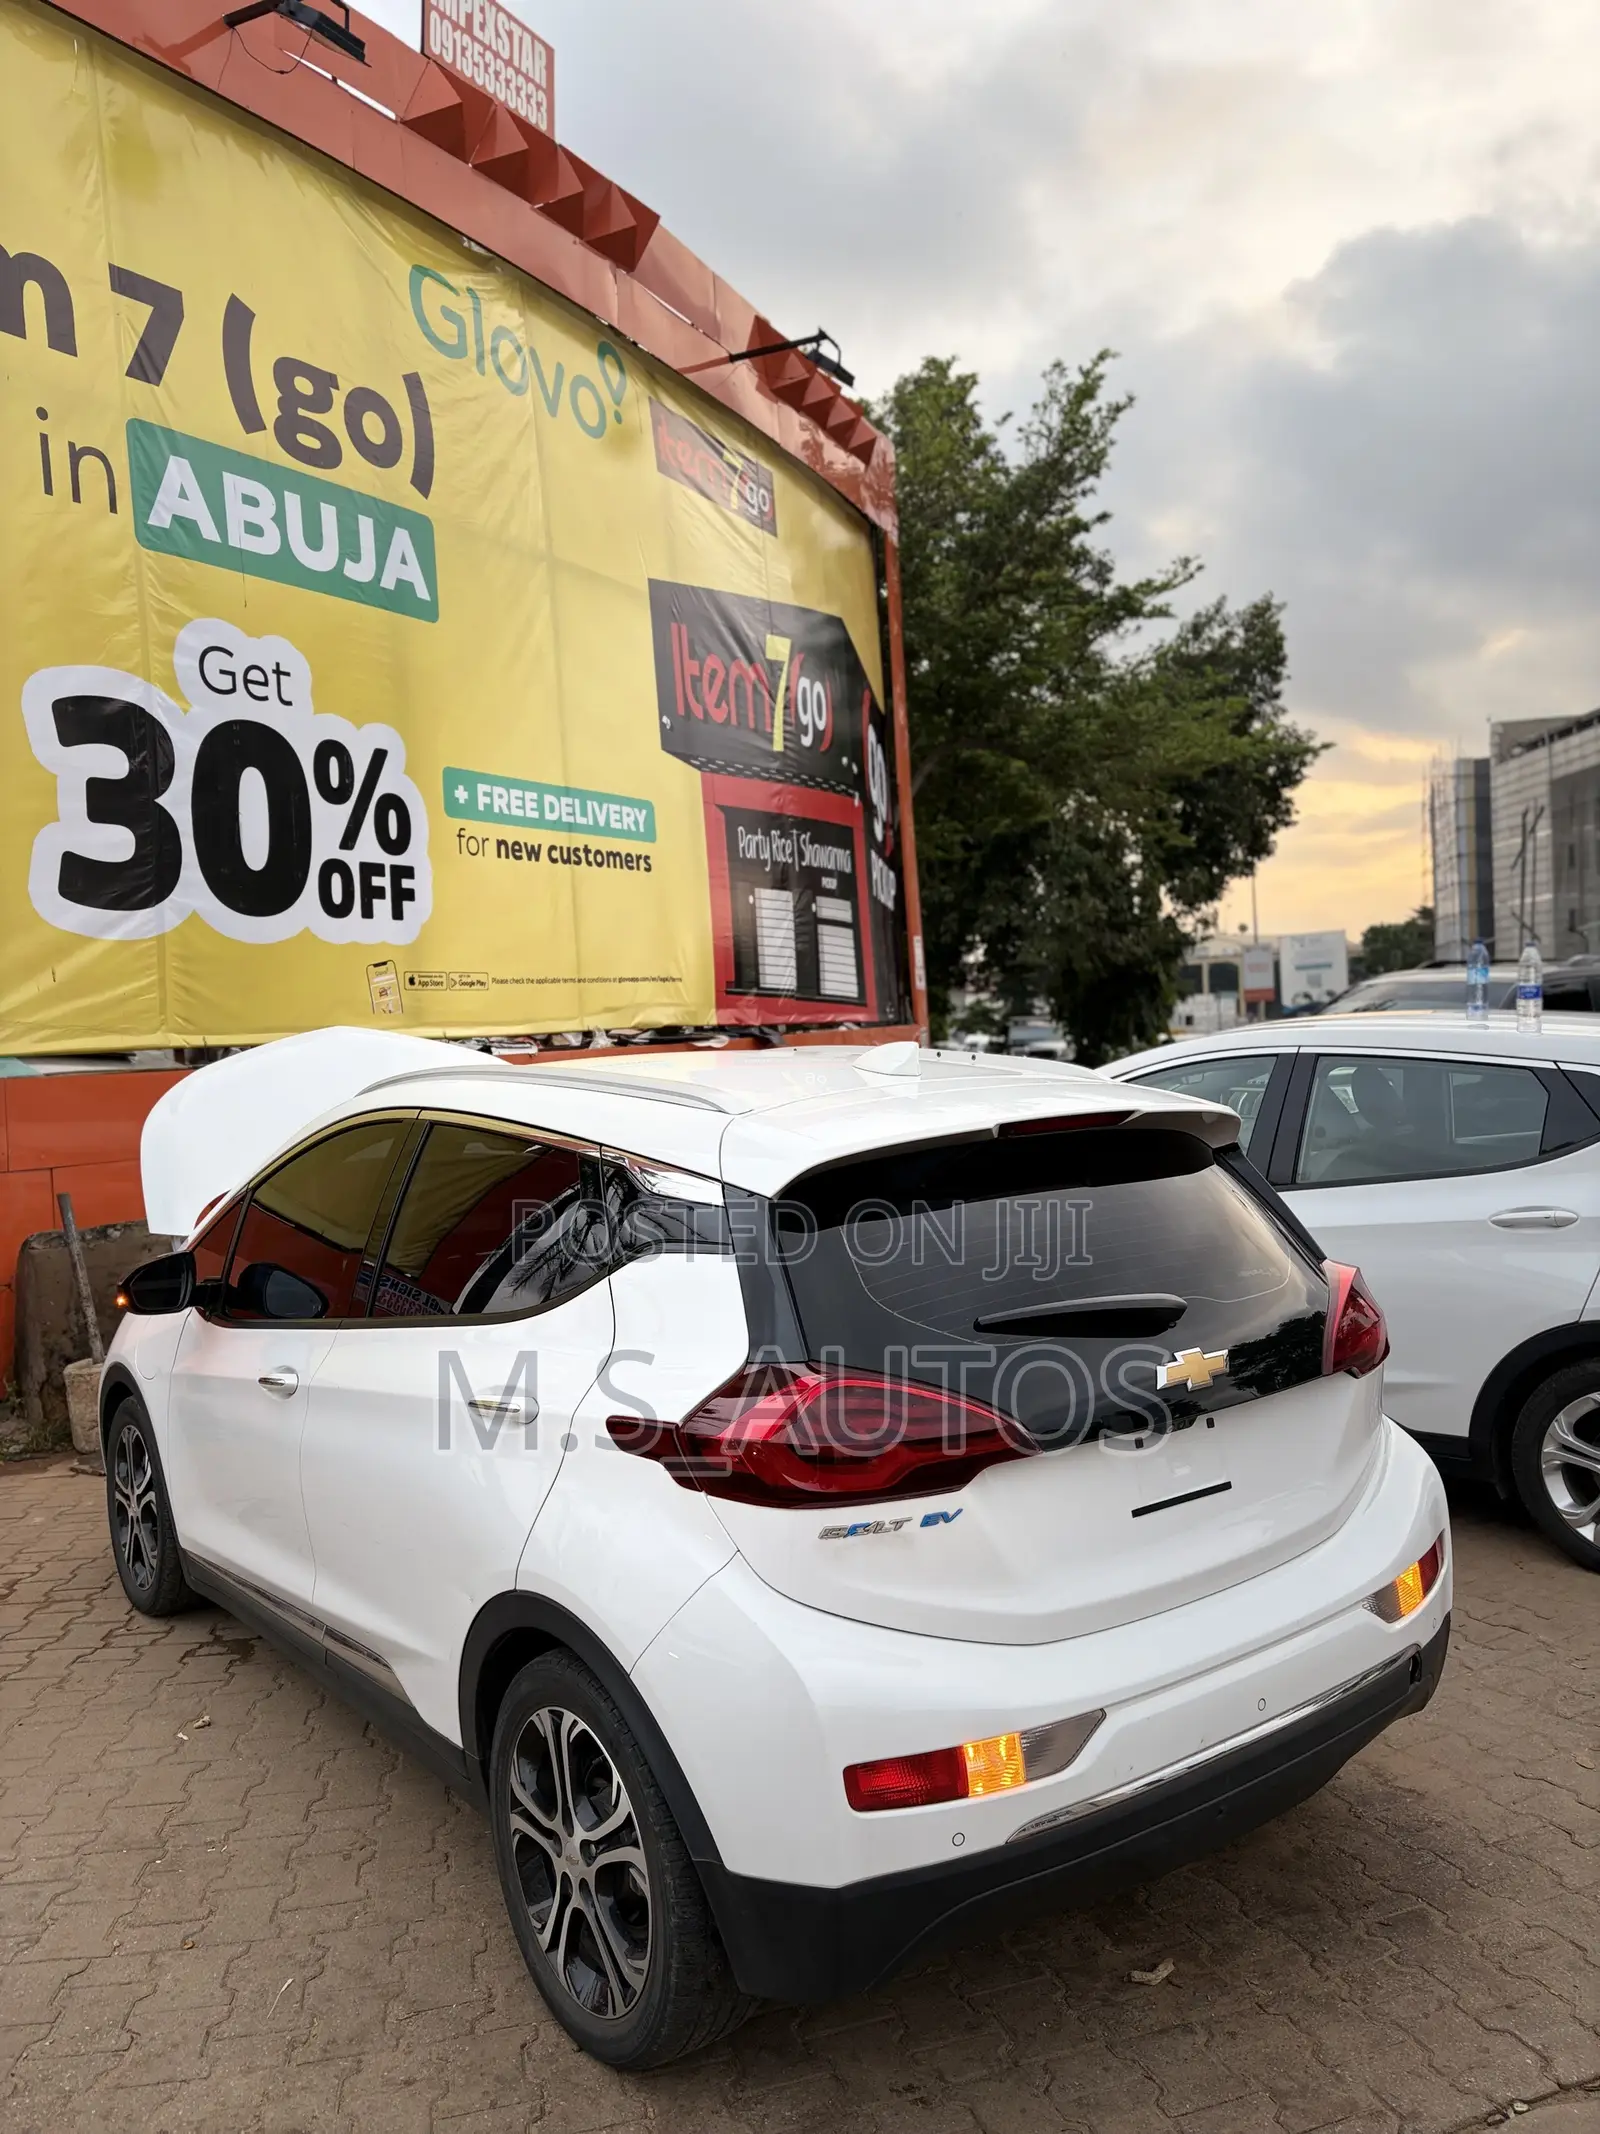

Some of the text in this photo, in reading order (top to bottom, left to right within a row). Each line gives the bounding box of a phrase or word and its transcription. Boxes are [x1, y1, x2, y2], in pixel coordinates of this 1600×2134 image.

[430, 0, 547, 89] PEXSTAR
[430, 10, 547, 131] 09135333333
[108, 262, 185, 387] 7
[222, 293, 435, 500] (go)
[36, 406, 432, 602] in ABUJA
[198, 645, 293, 706] Get
[51, 694, 412, 917] 30%
[477, 783, 539, 819] FREE
[543, 794, 648, 833] DELIVERY
[456, 827, 652, 873] for new customers
[737, 826, 771, 872] Party
[771, 829, 793, 863] Rice
[317, 858, 415, 920] OFF
[418, 980, 430, 988] App
[458, 980, 475, 988] Google
[491, 977, 508, 985] Please
[920, 1508, 964, 1528] EV
